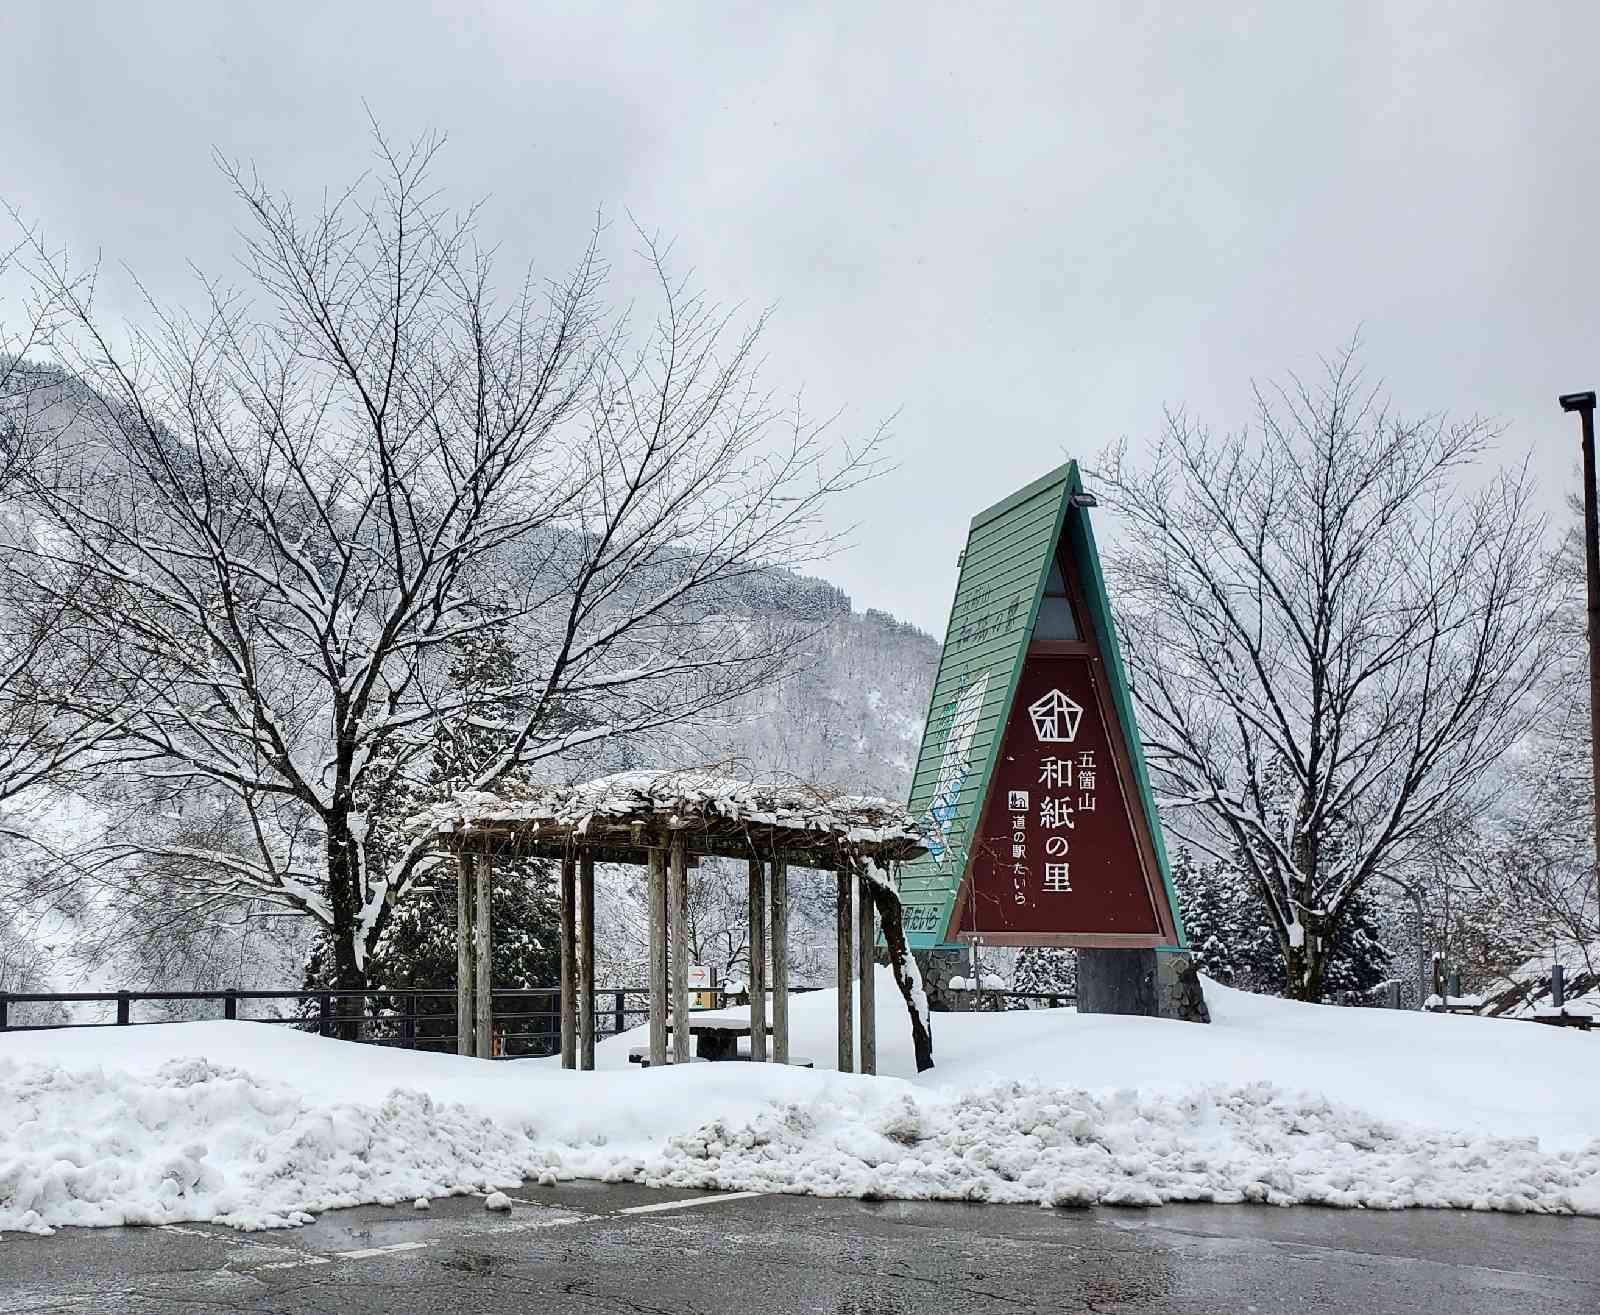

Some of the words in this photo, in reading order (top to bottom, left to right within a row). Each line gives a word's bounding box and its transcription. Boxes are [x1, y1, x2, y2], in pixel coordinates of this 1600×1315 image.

[1038, 756, 1075, 892] 和紙の里
[1076, 750, 1097, 811] 五箇山
